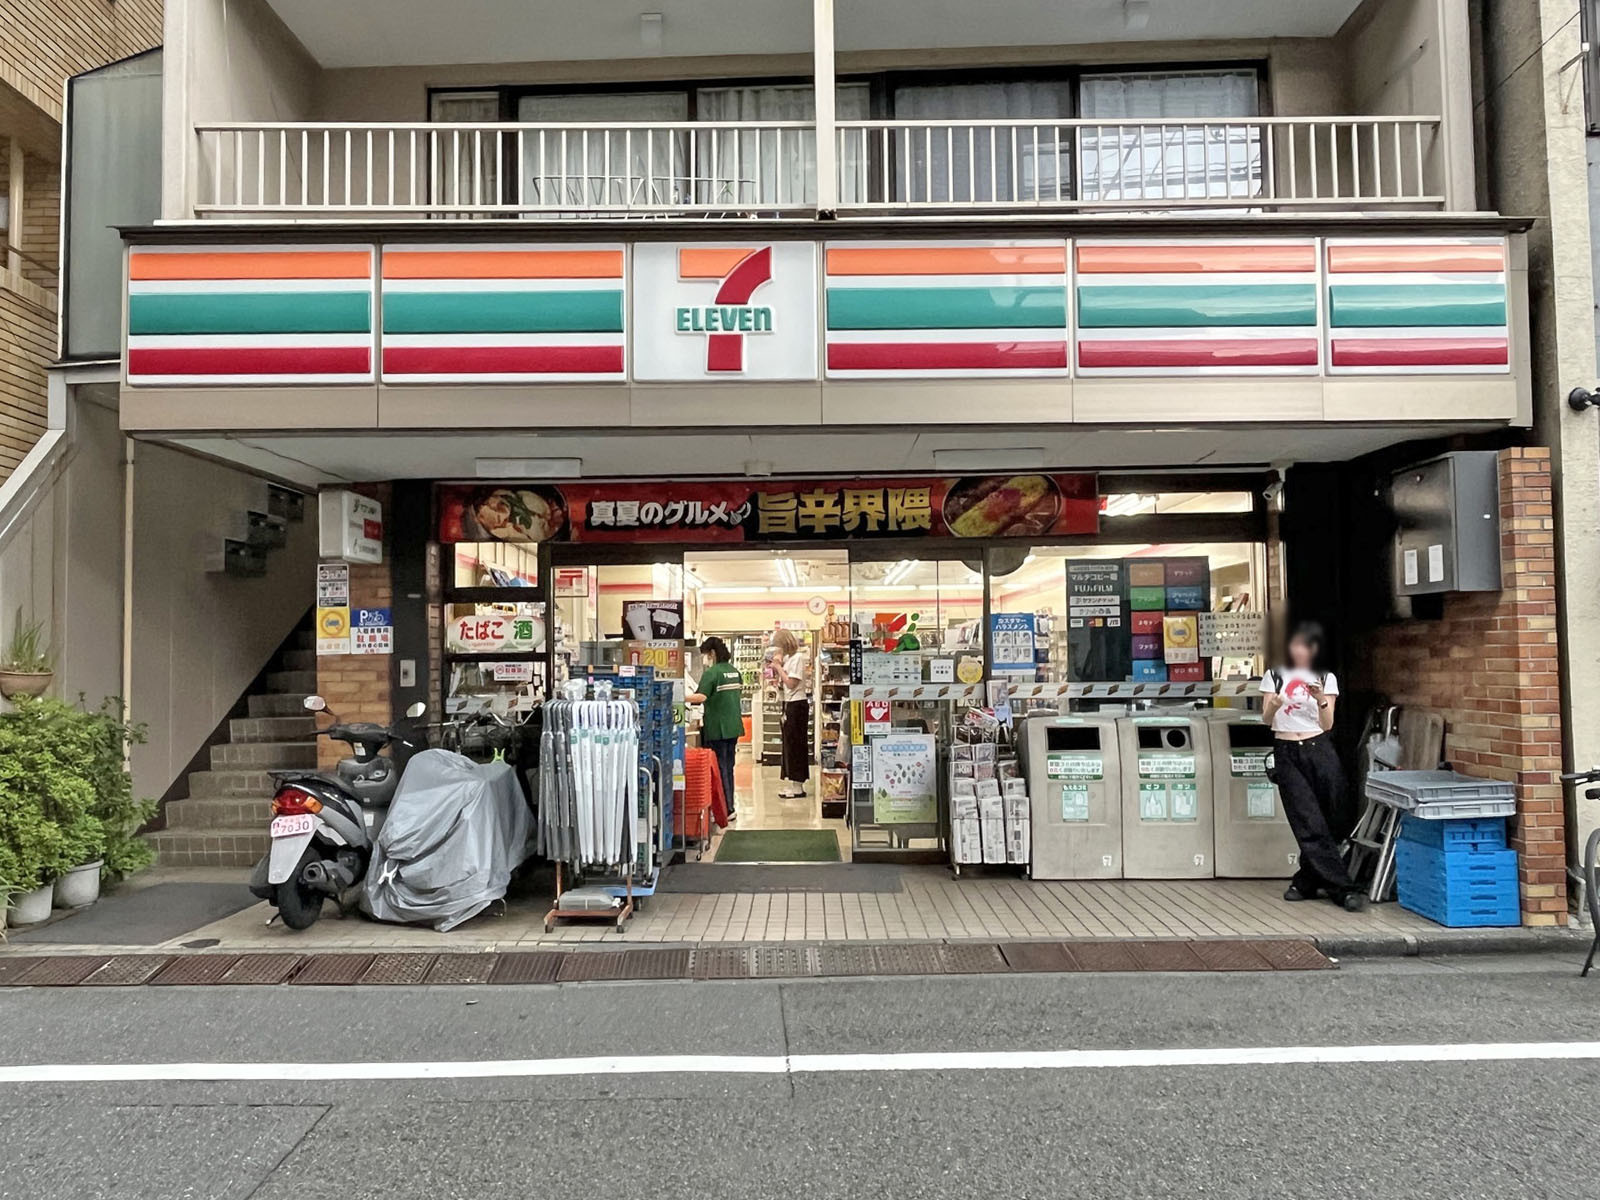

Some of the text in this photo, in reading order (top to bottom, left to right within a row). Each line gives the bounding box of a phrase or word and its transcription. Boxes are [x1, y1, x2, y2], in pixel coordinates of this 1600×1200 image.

[680, 246, 772, 371] 7
[591, 500, 732, 527] 真夏のグルメ
[757, 487, 932, 533] 旨辛界隈
[460, 620, 504, 640] たばこ
[513, 620, 533, 639] 酒
